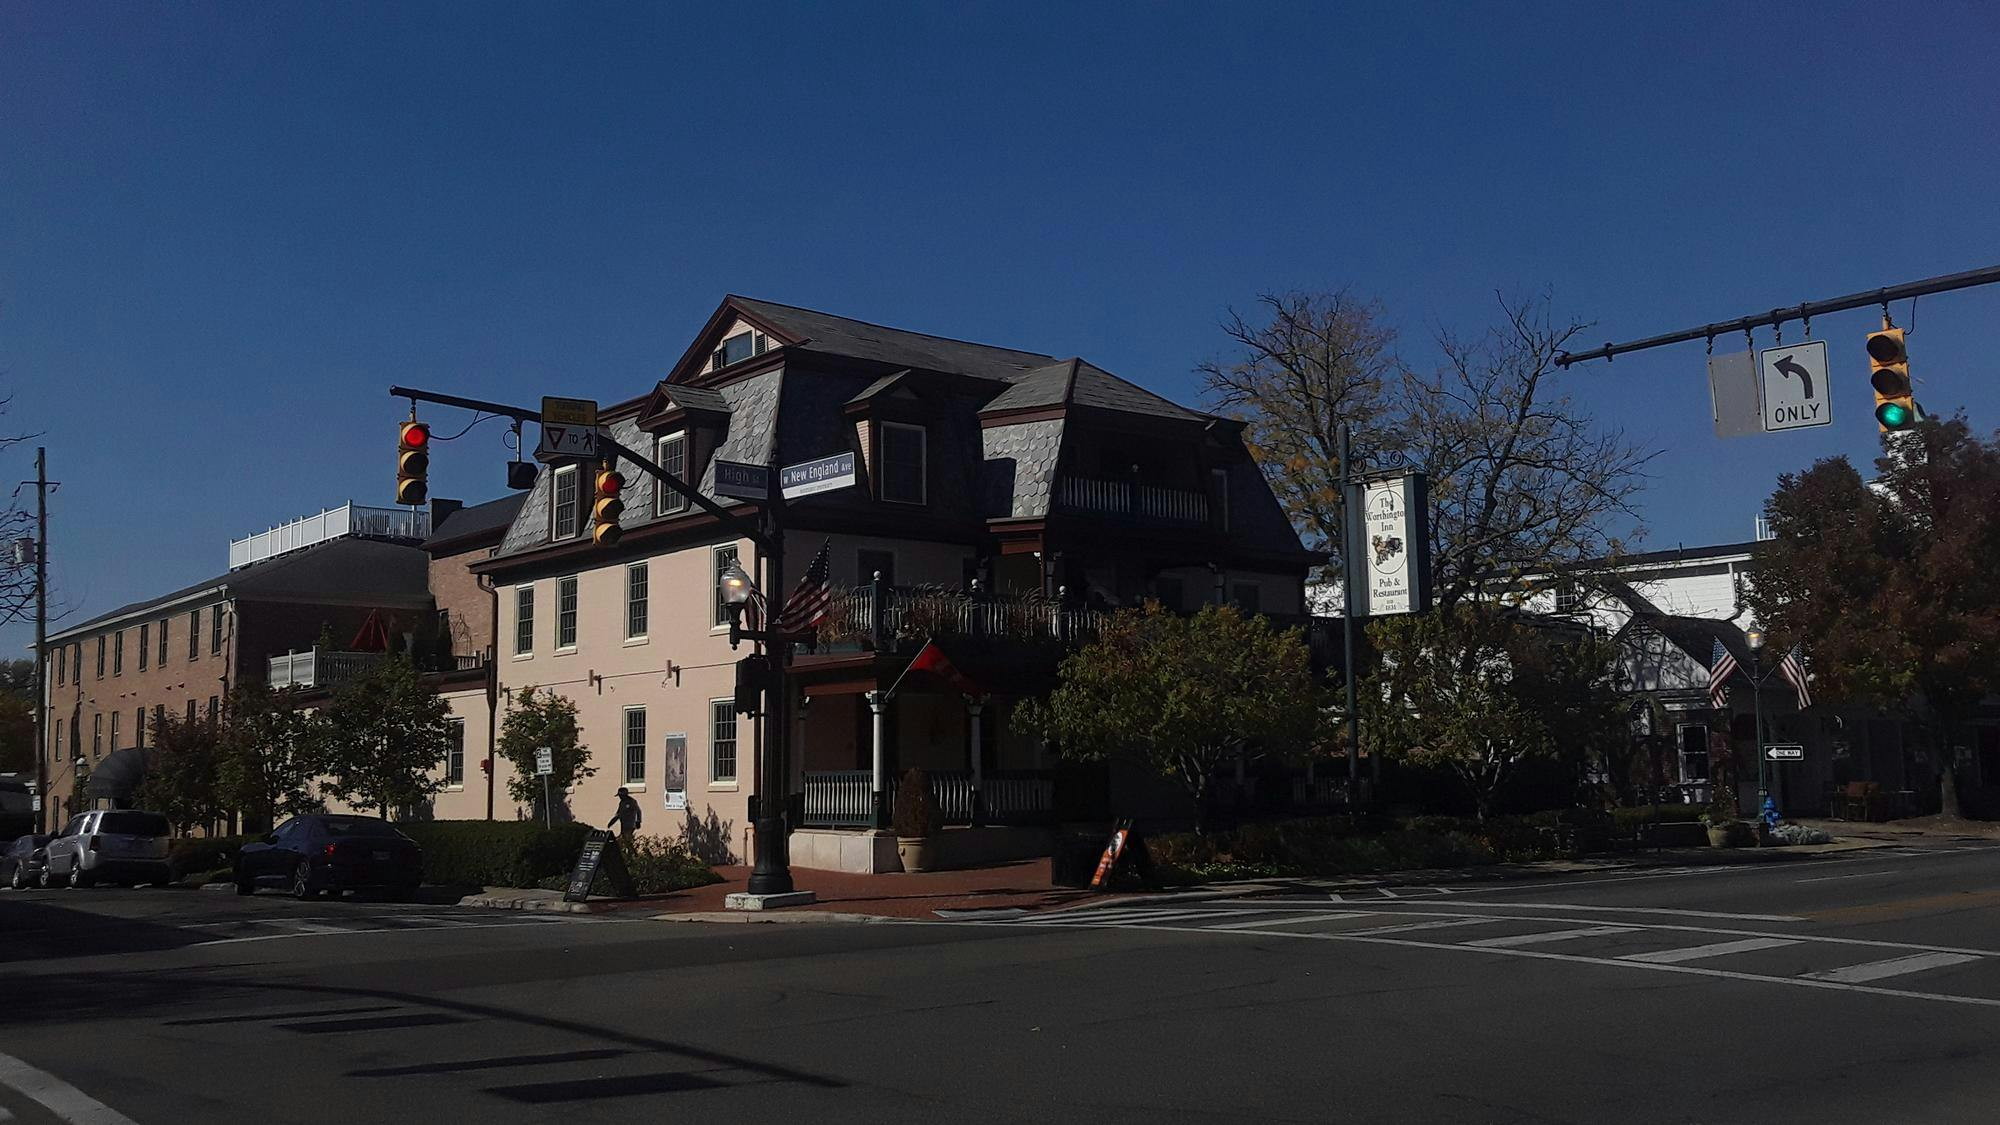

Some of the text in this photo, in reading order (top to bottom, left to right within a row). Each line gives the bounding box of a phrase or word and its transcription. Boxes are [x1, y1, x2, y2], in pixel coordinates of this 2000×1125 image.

[1775, 403, 1819, 423] ONLY
[568, 433, 578, 444] TO
[724, 467, 749, 485] High
[791, 470, 807, 483] New
[809, 461, 840, 480] England
[841, 462, 853, 472] Ave
[1365, 509, 1405, 521] Worthingto
[1381, 522, 1394, 532] Inn
[1379, 577, 1401, 588] Pub &
[1373, 588, 1408, 598] Restaurant
